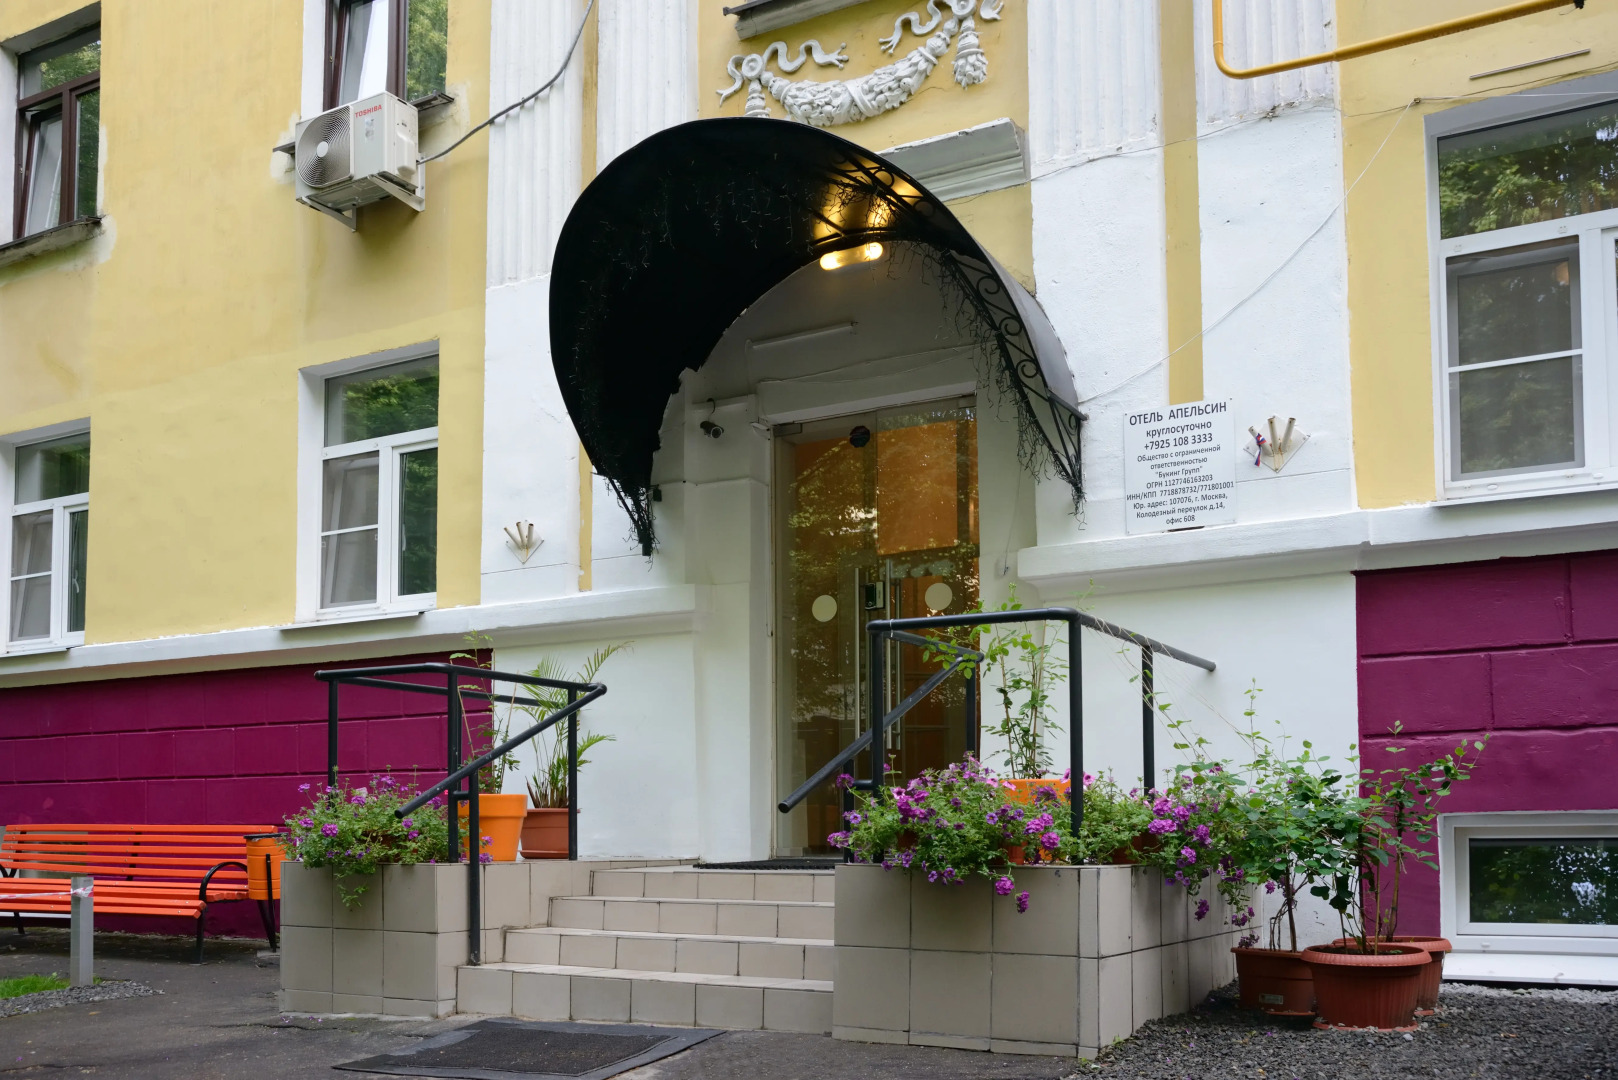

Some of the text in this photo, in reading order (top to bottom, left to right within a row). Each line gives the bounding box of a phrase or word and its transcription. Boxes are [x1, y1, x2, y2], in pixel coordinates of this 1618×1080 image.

[355, 105, 382, 118] TOSHIBA
[1130, 402, 1226, 425] ОТЕЛЬ АПЕЛЬСИН
[1146, 421, 1211, 438] круглосуточно
[1144, 433, 1212, 450] +7925 108 3333
[1137, 453, 1168, 462] Общество
[1174, 445, 1221, 457] ограниченной
[1151, 457, 1207, 469] ответственностью
[1146, 474, 1213, 489] ОГРН 1127746163203
[1127, 481, 1234, 501] ИНН/КПП 7718878732/771801001
[1147, 500, 1167, 509] адрес:
[1170, 496, 1193, 505] 107076,
[1201, 493, 1227, 501] Москва,
[1136, 507, 1175, 518] Колодезный
[1178, 504, 1207, 514] переулок
[1166, 517, 1182, 525] офис
